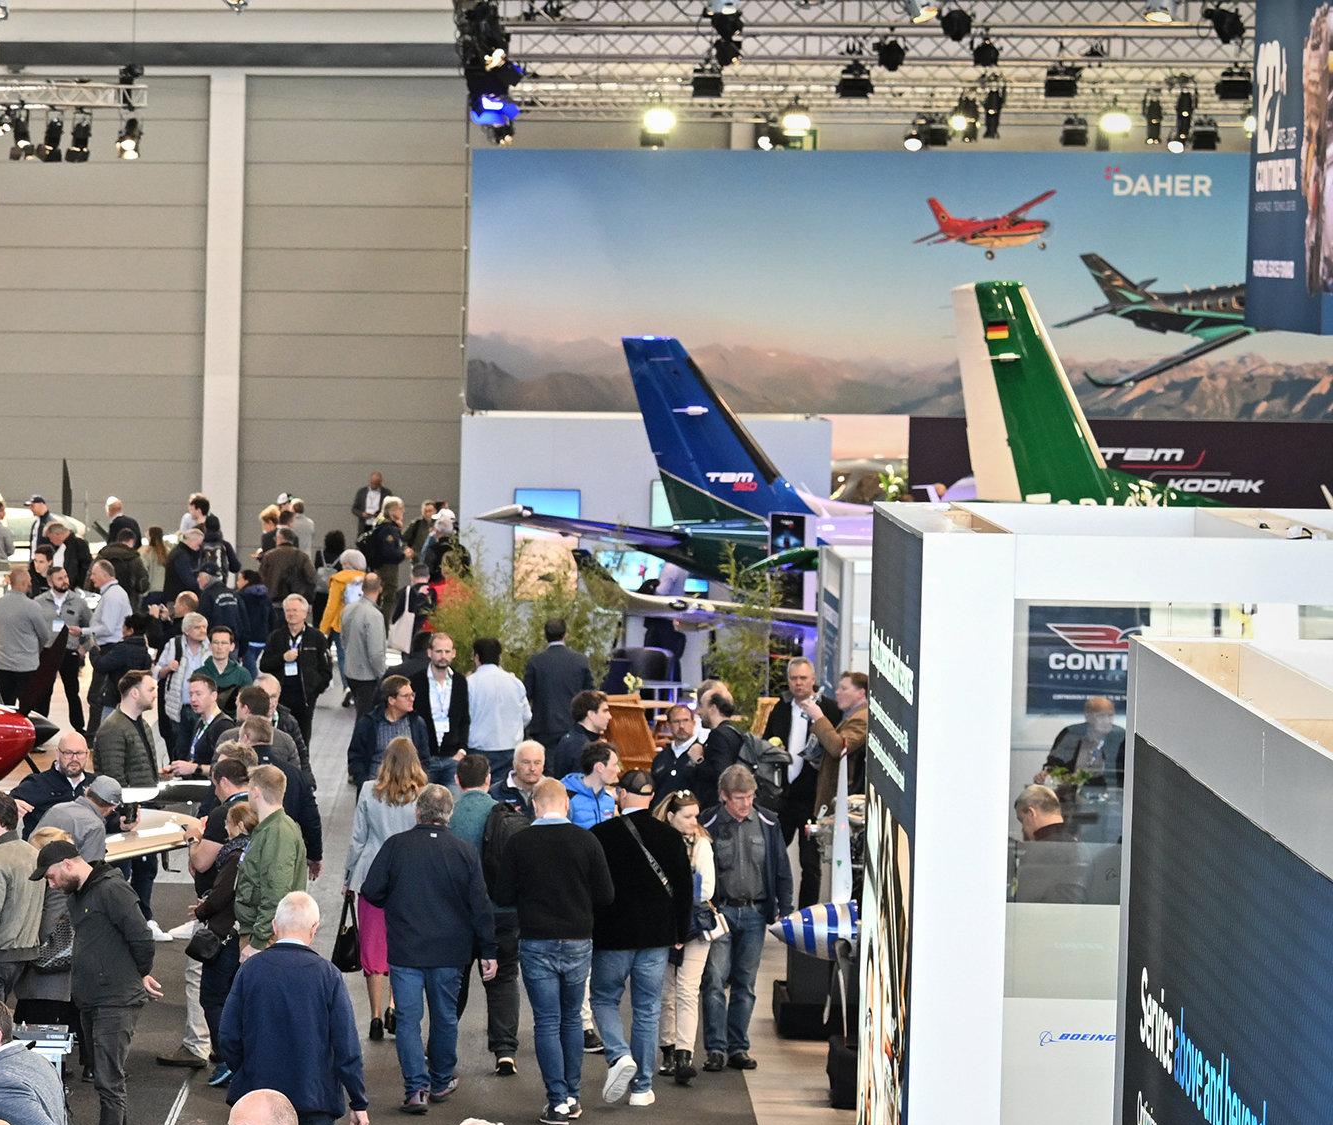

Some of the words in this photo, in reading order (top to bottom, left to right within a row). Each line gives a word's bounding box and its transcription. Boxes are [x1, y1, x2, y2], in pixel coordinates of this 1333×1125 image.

[1113, 174, 1212, 197] DAHER
[1099, 447, 1184, 461] TBM
[706, 472, 754, 483] TBM
[1167, 479, 1264, 493] KODIAK
[1049, 653, 1128, 670] CONTI
[1058, 1033, 1117, 1042] BOEING
[1140, 967, 1174, 1075] Service
[1174, 1007, 1204, 1111] above
